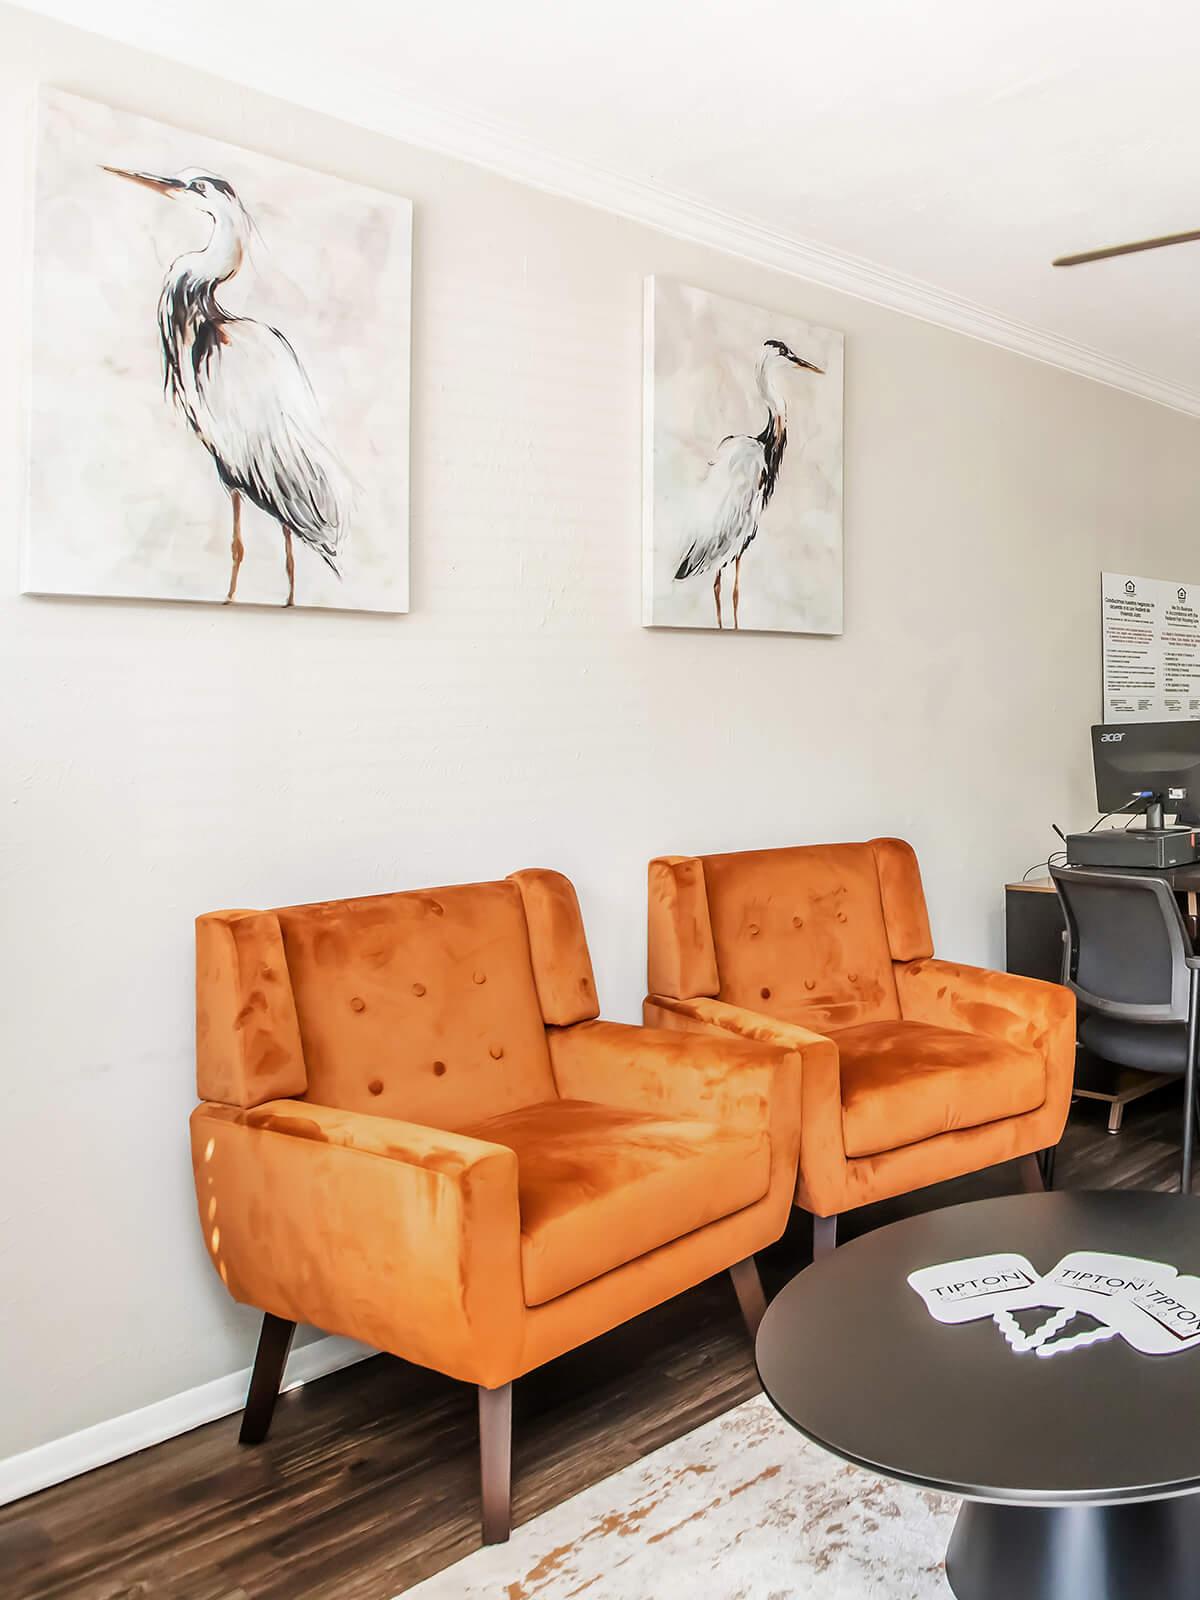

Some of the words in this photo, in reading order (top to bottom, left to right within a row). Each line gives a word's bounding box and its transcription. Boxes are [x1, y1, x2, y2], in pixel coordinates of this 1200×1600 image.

[1100, 732, 1126, 743] acer
[929, 1272, 1021, 1296] TIPTON
[1062, 1269, 1145, 1291] TIPTON
